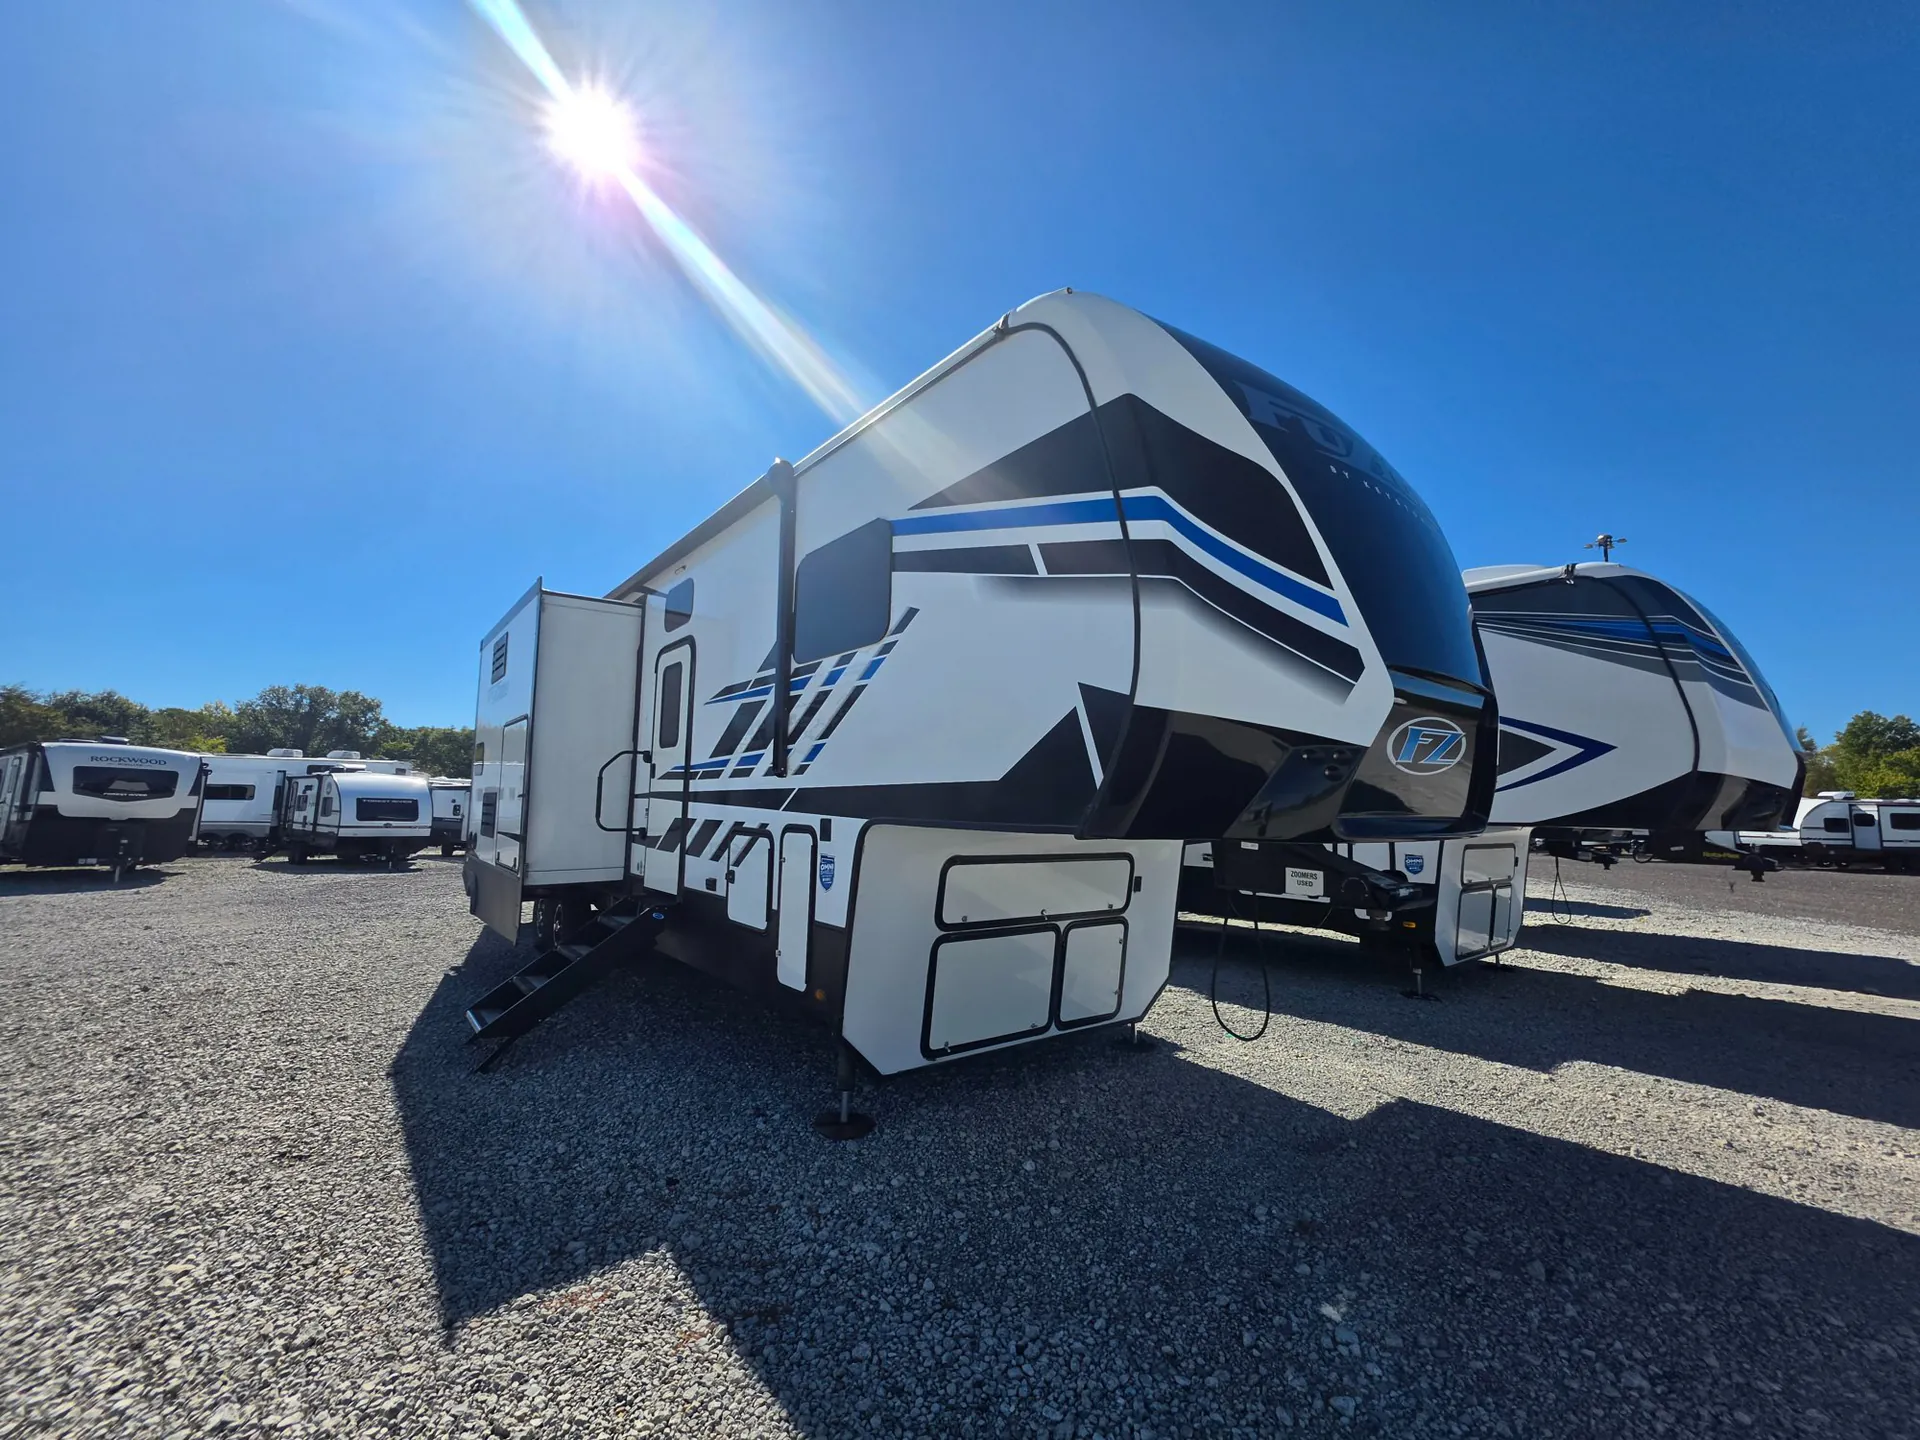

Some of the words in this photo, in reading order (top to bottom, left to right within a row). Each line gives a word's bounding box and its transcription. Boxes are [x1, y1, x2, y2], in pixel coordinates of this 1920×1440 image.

[1396, 725, 1466, 765] FZ
[90, 755, 167, 766] ROCKWOOD
[1290, 870, 1318, 880] ZOOMERS
